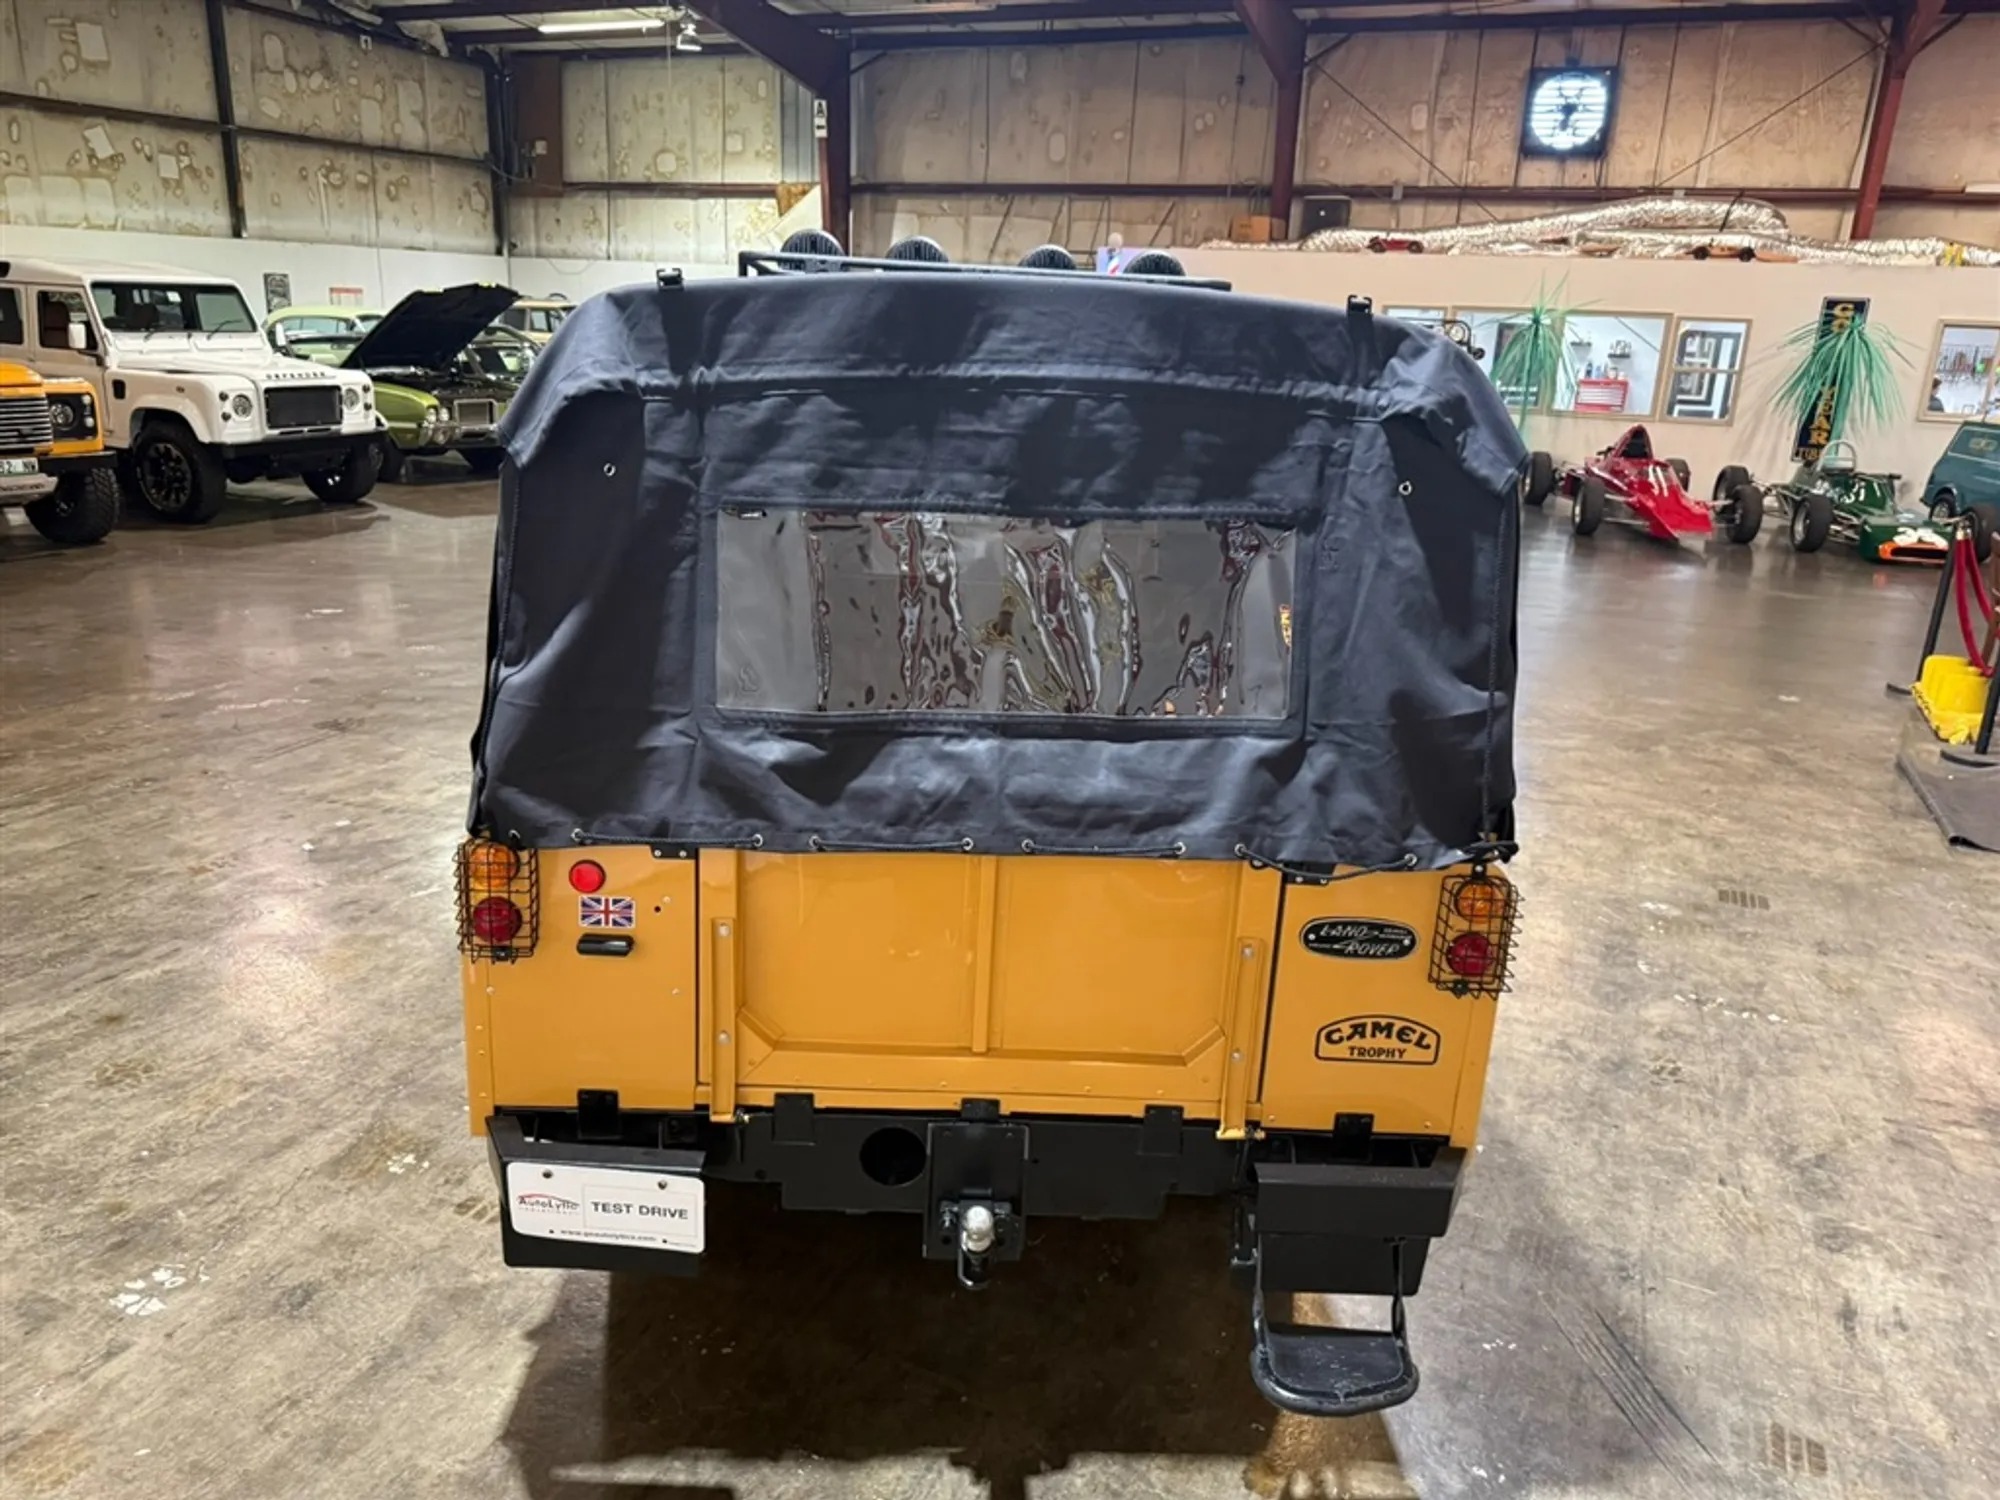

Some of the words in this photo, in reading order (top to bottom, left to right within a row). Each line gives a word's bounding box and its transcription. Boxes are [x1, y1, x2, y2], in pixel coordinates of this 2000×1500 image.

[1320, 925, 1369, 937] LAND
[1344, 941, 1400, 956] ROVER
[1324, 1020, 1432, 1050] CAMEL
[1348, 1045, 1407, 1059] TROPHY
[591, 1201, 633, 1215] TEST
[638, 1204, 689, 1220] DRIVE
